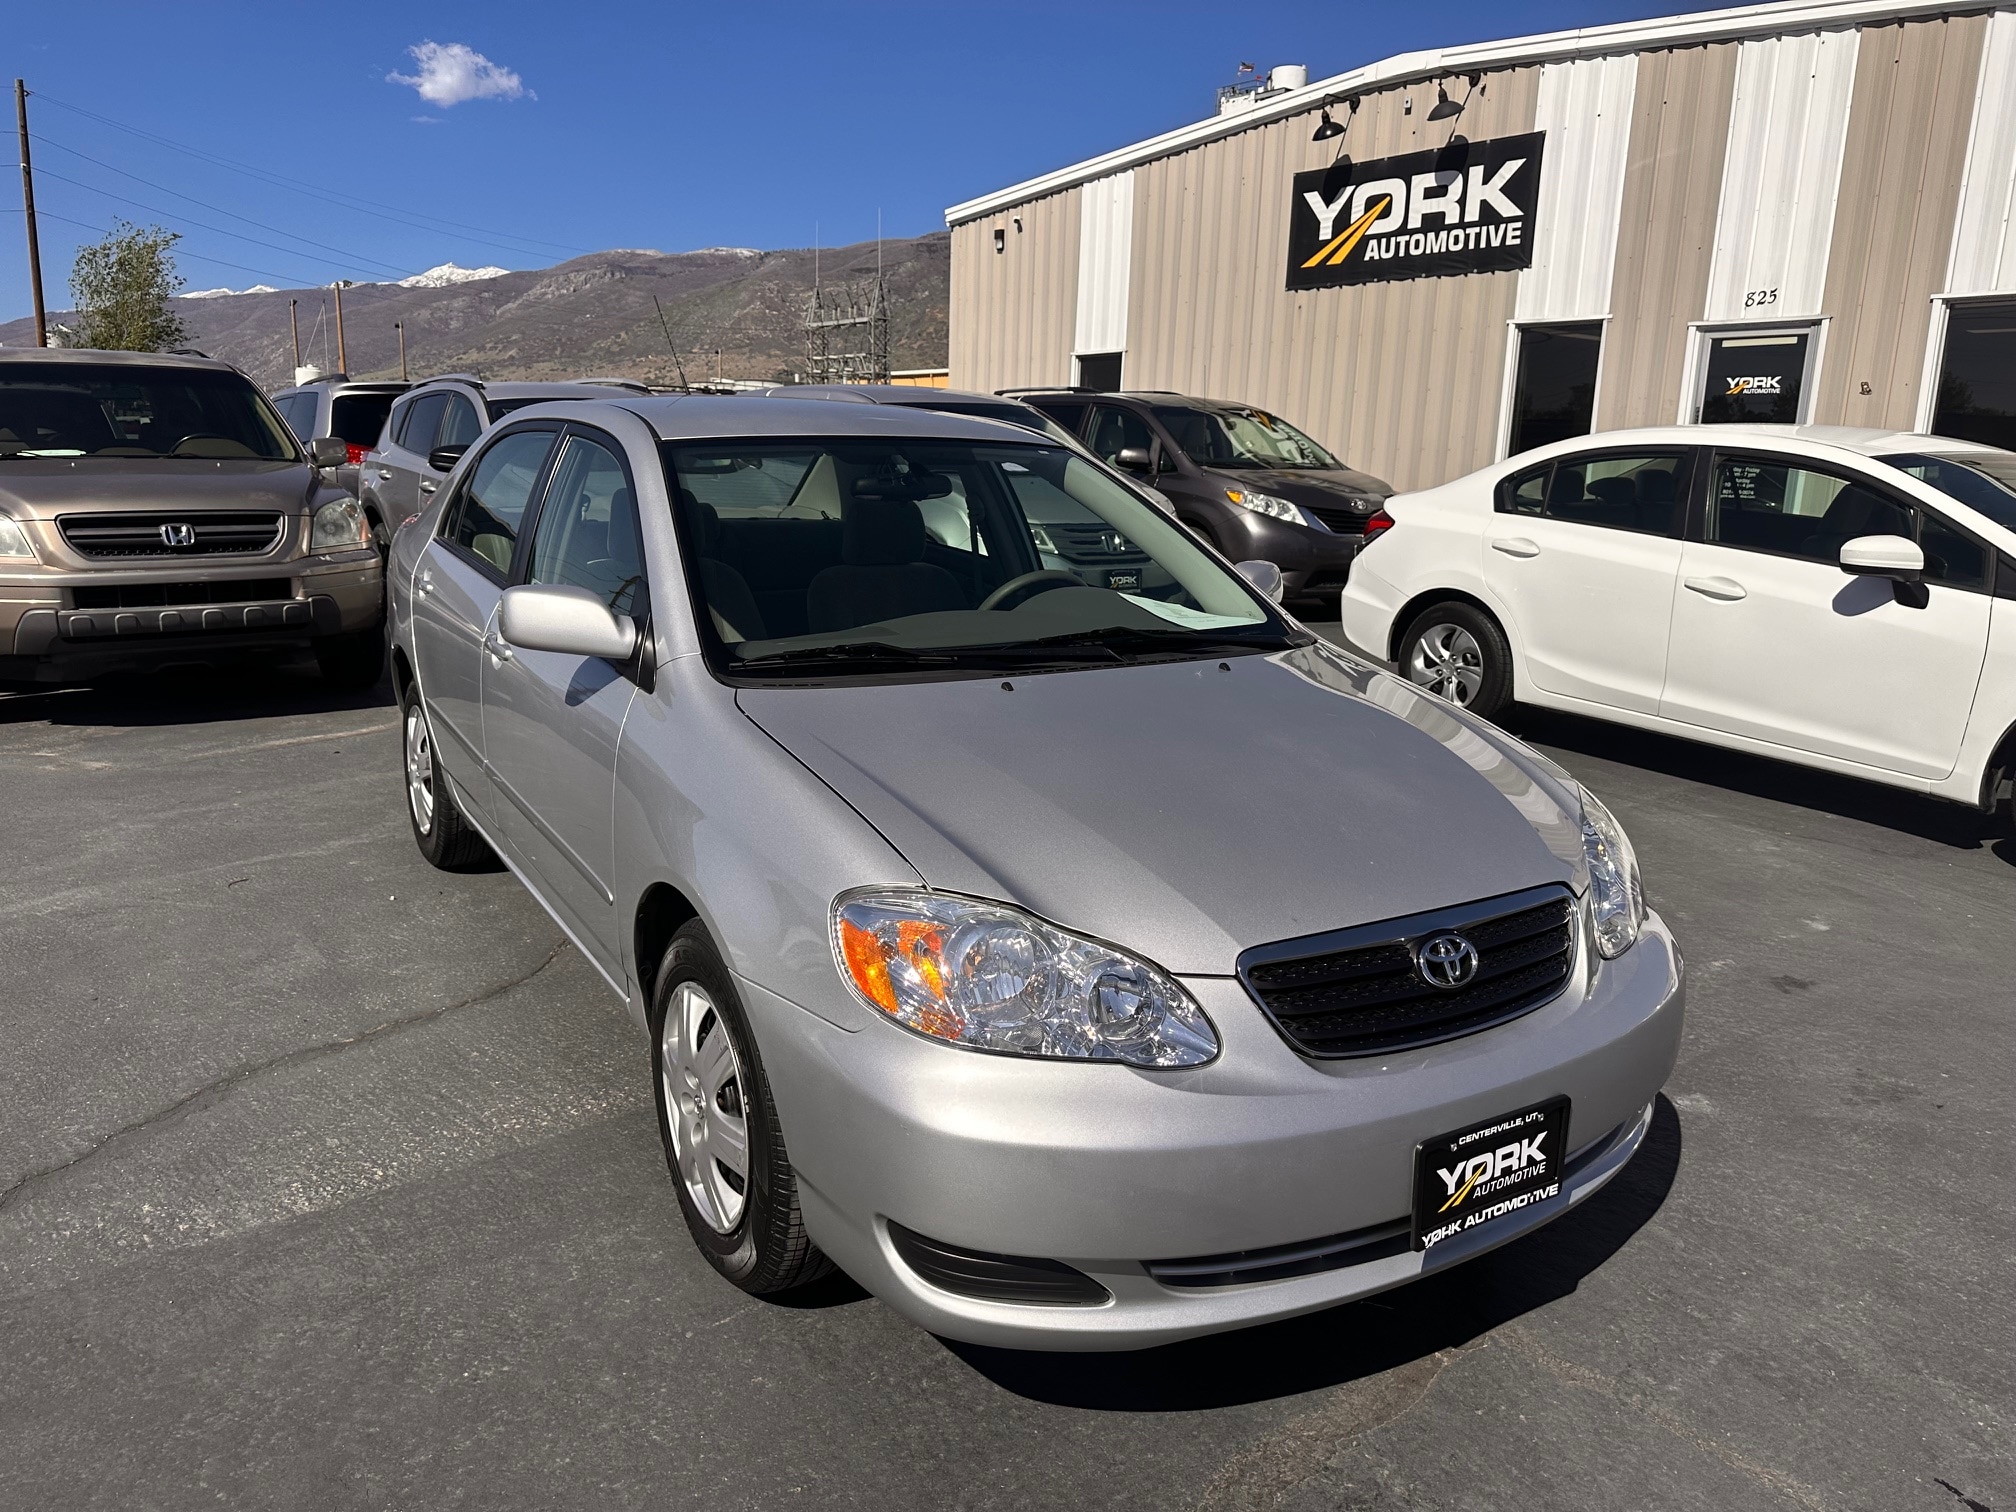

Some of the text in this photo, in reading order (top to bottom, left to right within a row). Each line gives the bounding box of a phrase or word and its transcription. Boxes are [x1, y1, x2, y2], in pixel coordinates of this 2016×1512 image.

[1303, 158, 1527, 241] YORK
[1364, 221, 1522, 261] AUTOMOTIVE
[1744, 288, 1778, 307] 825
[1726, 376, 1782, 388] YORK
[1109, 576, 1137, 584] YORK
[1458, 1111, 1539, 1145] CENTERVILLE, UT
[1437, 1131, 1547, 1195] YORK
[1473, 1161, 1547, 1199] AUTOMOTIVE
[1421, 1183, 1559, 1247] YORK AUTOMOTIVE
